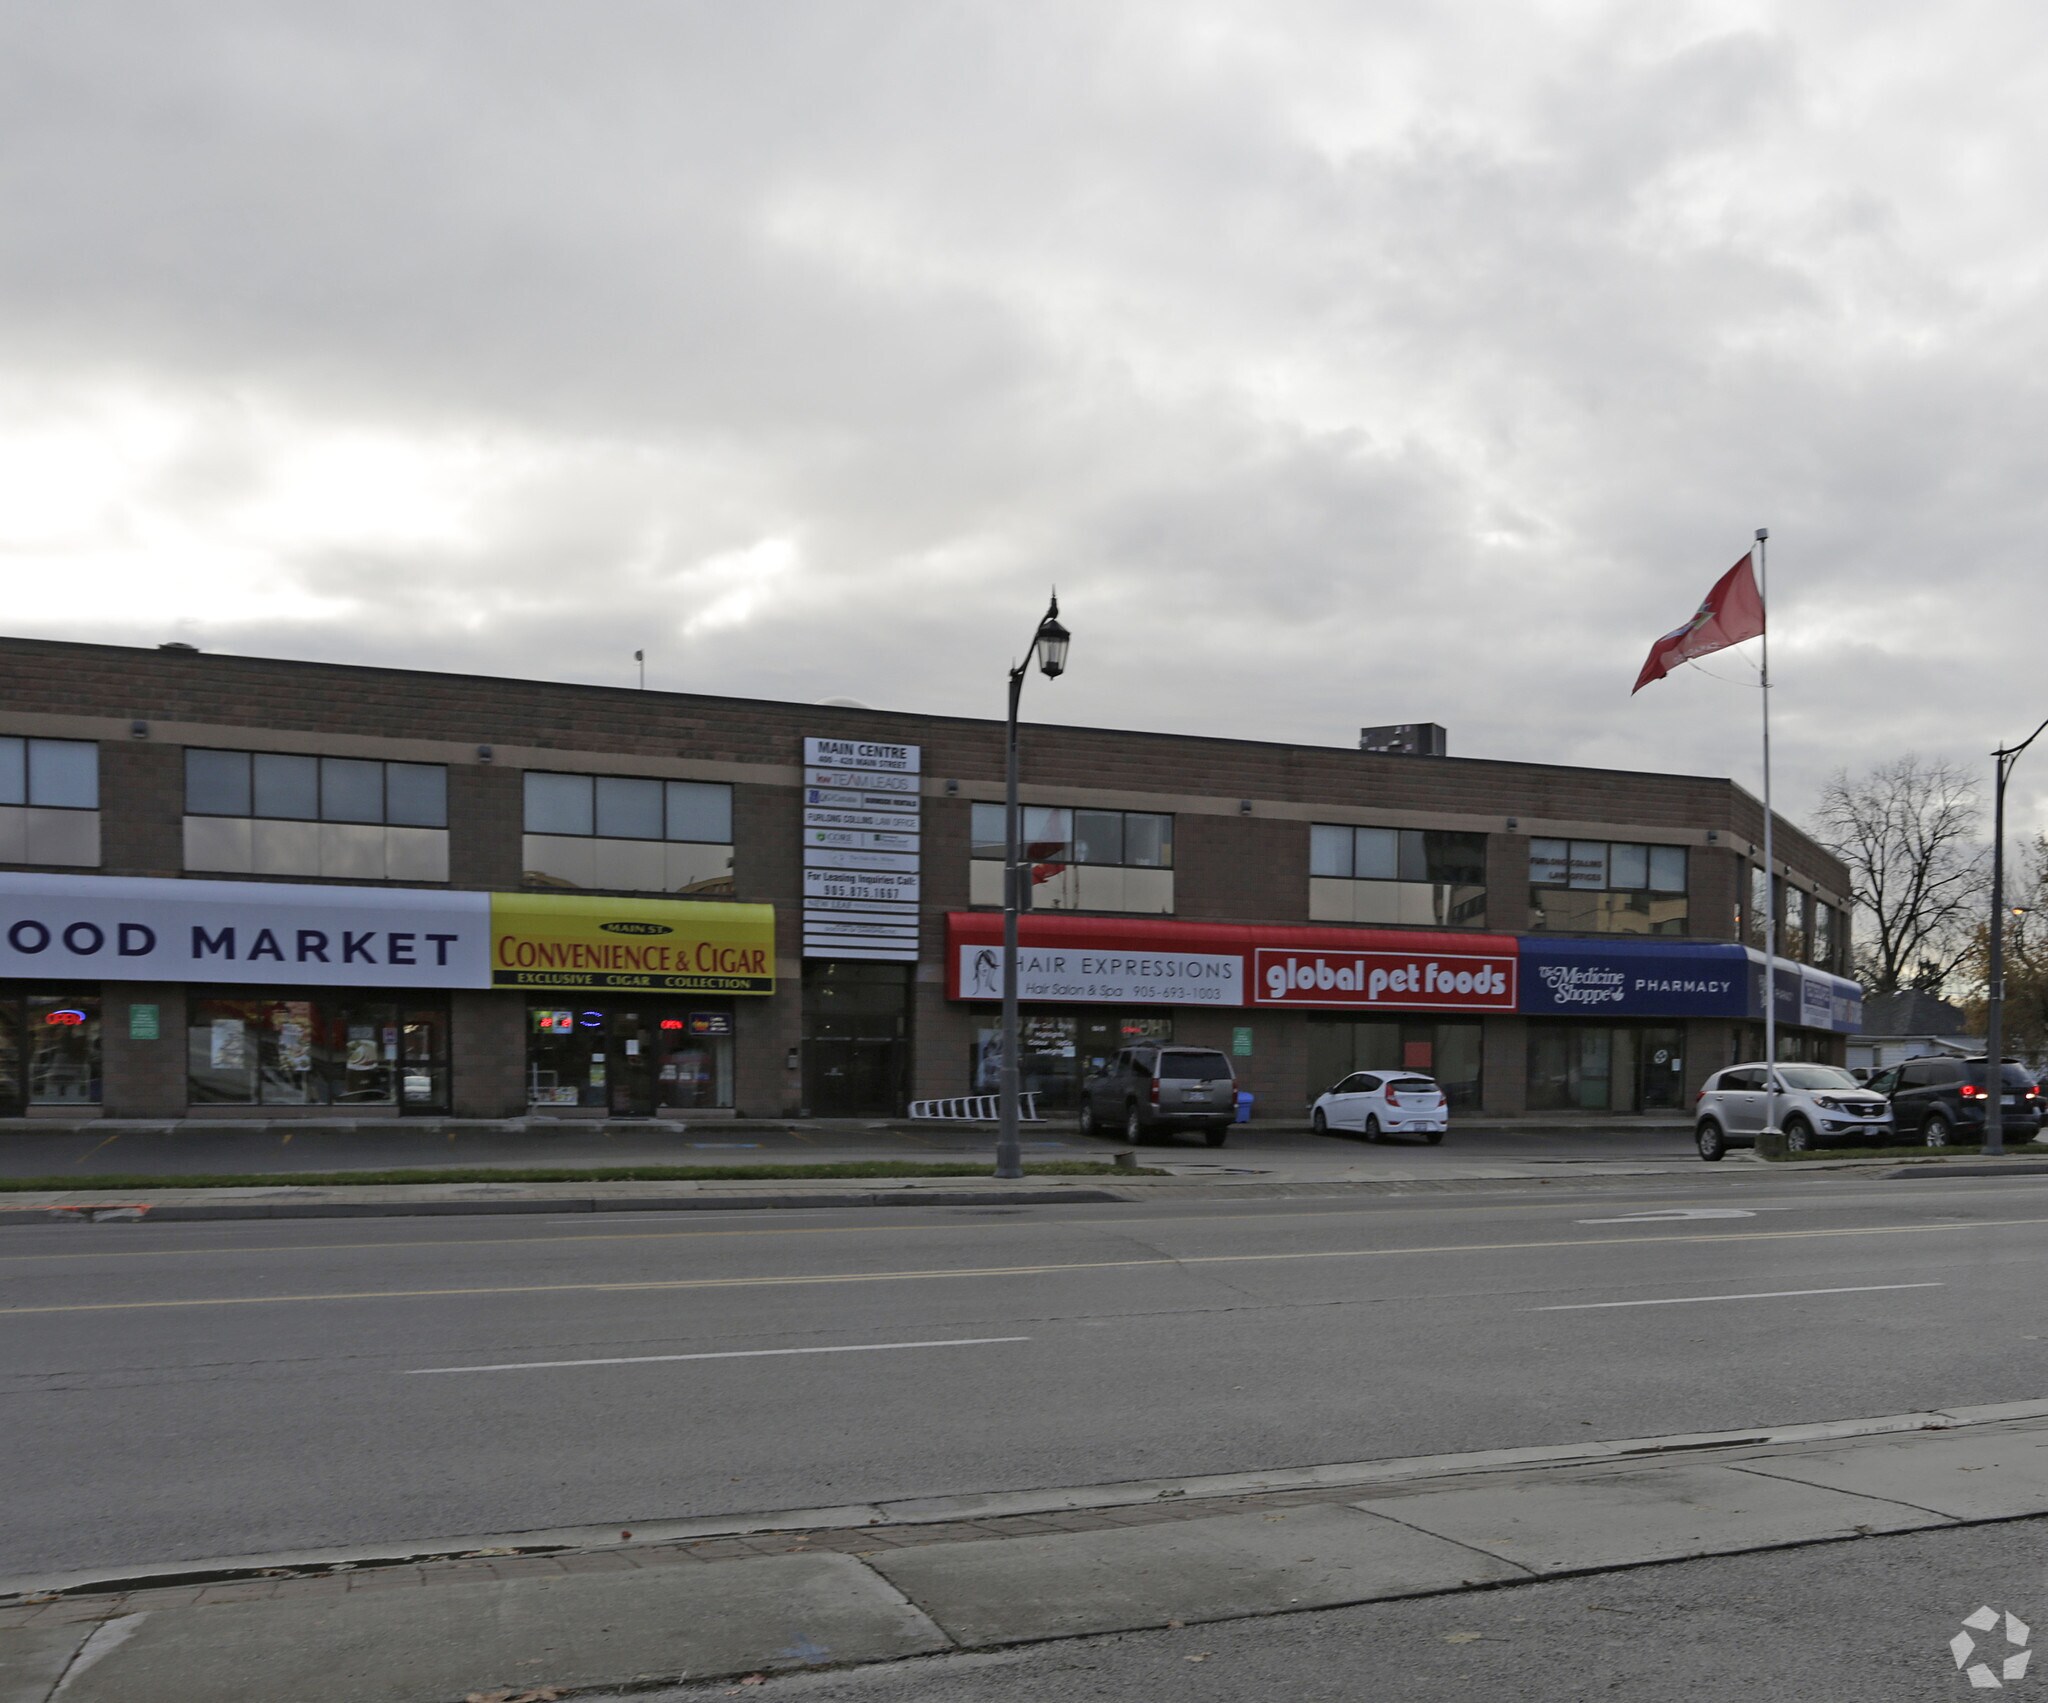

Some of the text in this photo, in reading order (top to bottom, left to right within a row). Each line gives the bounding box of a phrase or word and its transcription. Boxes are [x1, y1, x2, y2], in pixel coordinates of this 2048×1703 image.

[818, 741, 907, 759] MAIN CENTRE
[856, 758, 877, 767] MAIN
[879, 760, 907, 769] STREET
[844, 815, 873, 825] COLLINS
[807, 871, 917, 886] For Leasing Inquiries Call:
[607, 924, 646, 933] MAIN
[191, 926, 458, 966] MARKET
[500, 936, 766, 974] CONVENIENCE & CIGAR
[1081, 957, 1234, 979] EXPRESSIONS
[517, 973, 751, 990] EXCLUSIVE CIGAR COLLECTION
[1266, 958, 1506, 1000] global pet foods
[1547, 966, 1625, 988] Medicine
[1026, 983, 1222, 1000] Hair Salon & Spa 905-693-1003
[1554, 984, 1611, 1004] Shoppe
[1635, 979, 1731, 993] PHARMACY
